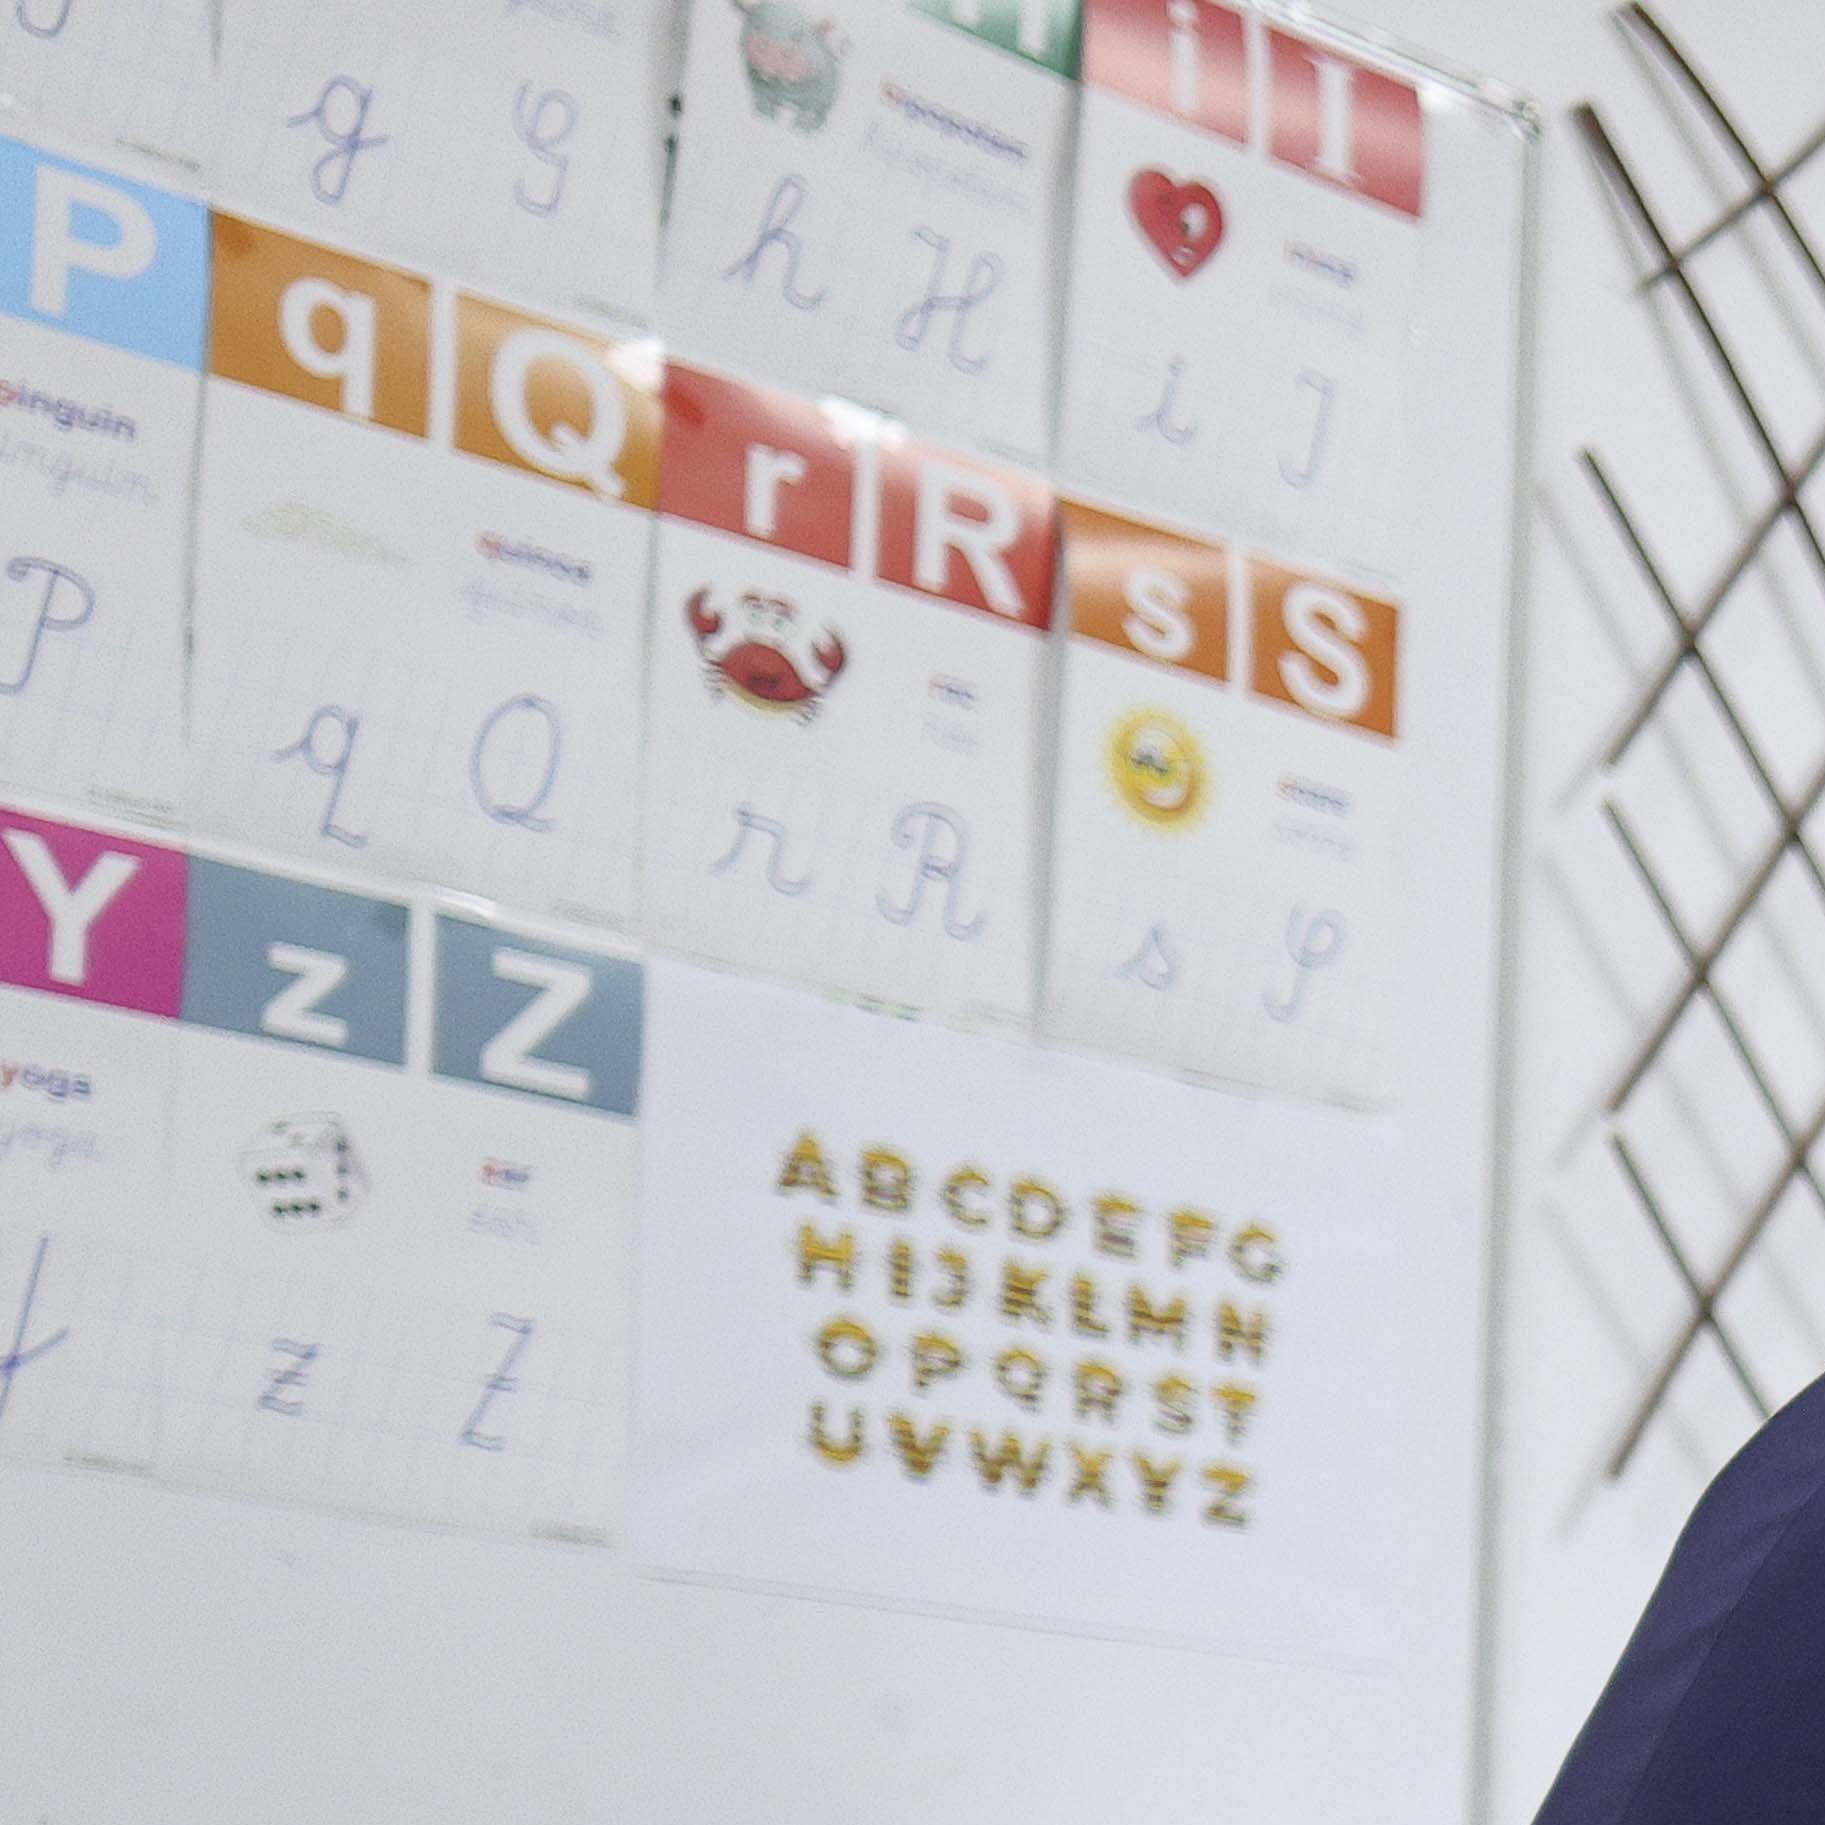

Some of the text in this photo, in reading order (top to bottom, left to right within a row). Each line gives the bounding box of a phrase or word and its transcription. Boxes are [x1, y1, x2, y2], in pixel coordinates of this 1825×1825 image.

[288, 75, 389, 204] g
[1167, 0, 1199, 112] i
[1303, 52, 1363, 185] I
[28, 163, 158, 316] P
[724, 174, 826, 311] h
[276, 277, 627, 500] q Q
[745, 442, 1024, 618] r R
[0, 556, 96, 694] P
[1121, 565, 1371, 718] s S
[269, 692, 558, 848] q Q
[0, 826, 144, 987] Y
[260, 940, 593, 1100] z Z
[459, 1312, 537, 1452] Z
